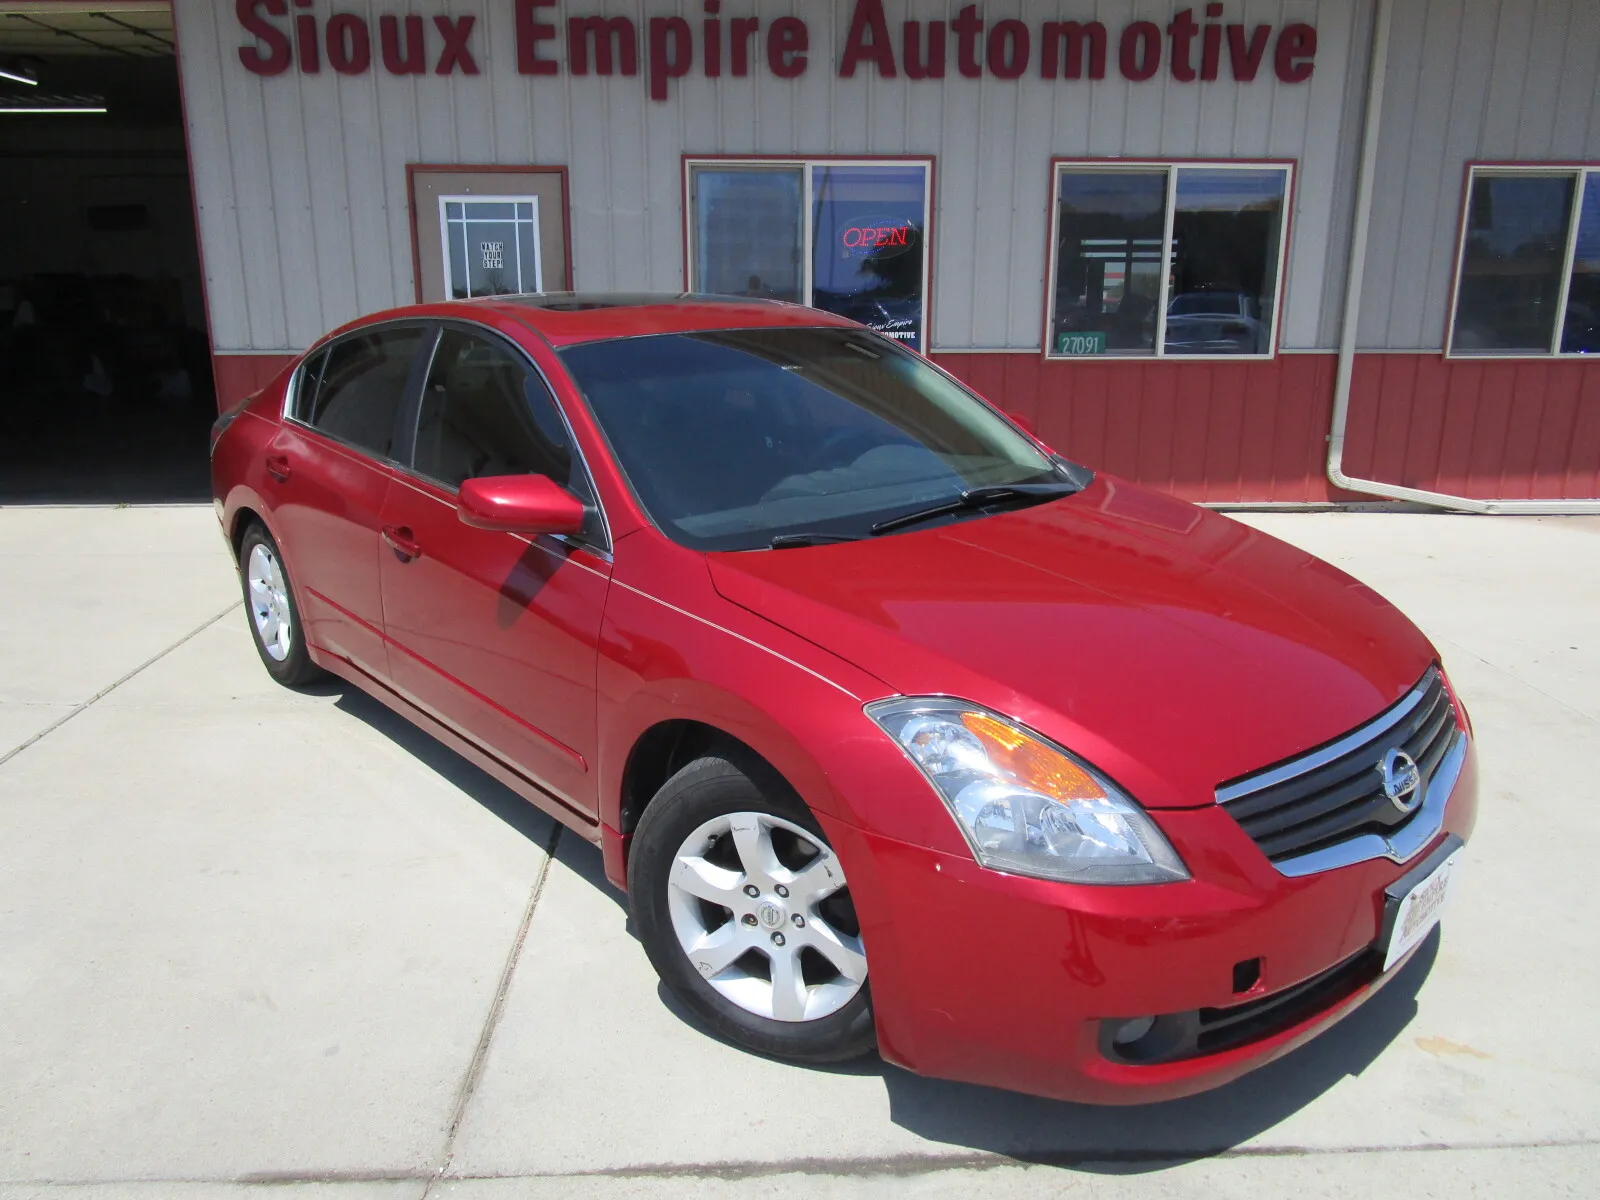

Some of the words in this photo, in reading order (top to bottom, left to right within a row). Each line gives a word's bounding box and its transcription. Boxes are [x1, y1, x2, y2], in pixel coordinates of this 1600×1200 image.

[236, 0, 480, 76] Sioux
[517, 0, 809, 101] Empire
[839, 0, 1318, 83] Automotive
[843, 226, 908, 247] OPEN
[481, 242, 503, 251] WATCH
[484, 251, 501, 260] YOUR
[1062, 336, 1099, 354] 27091
